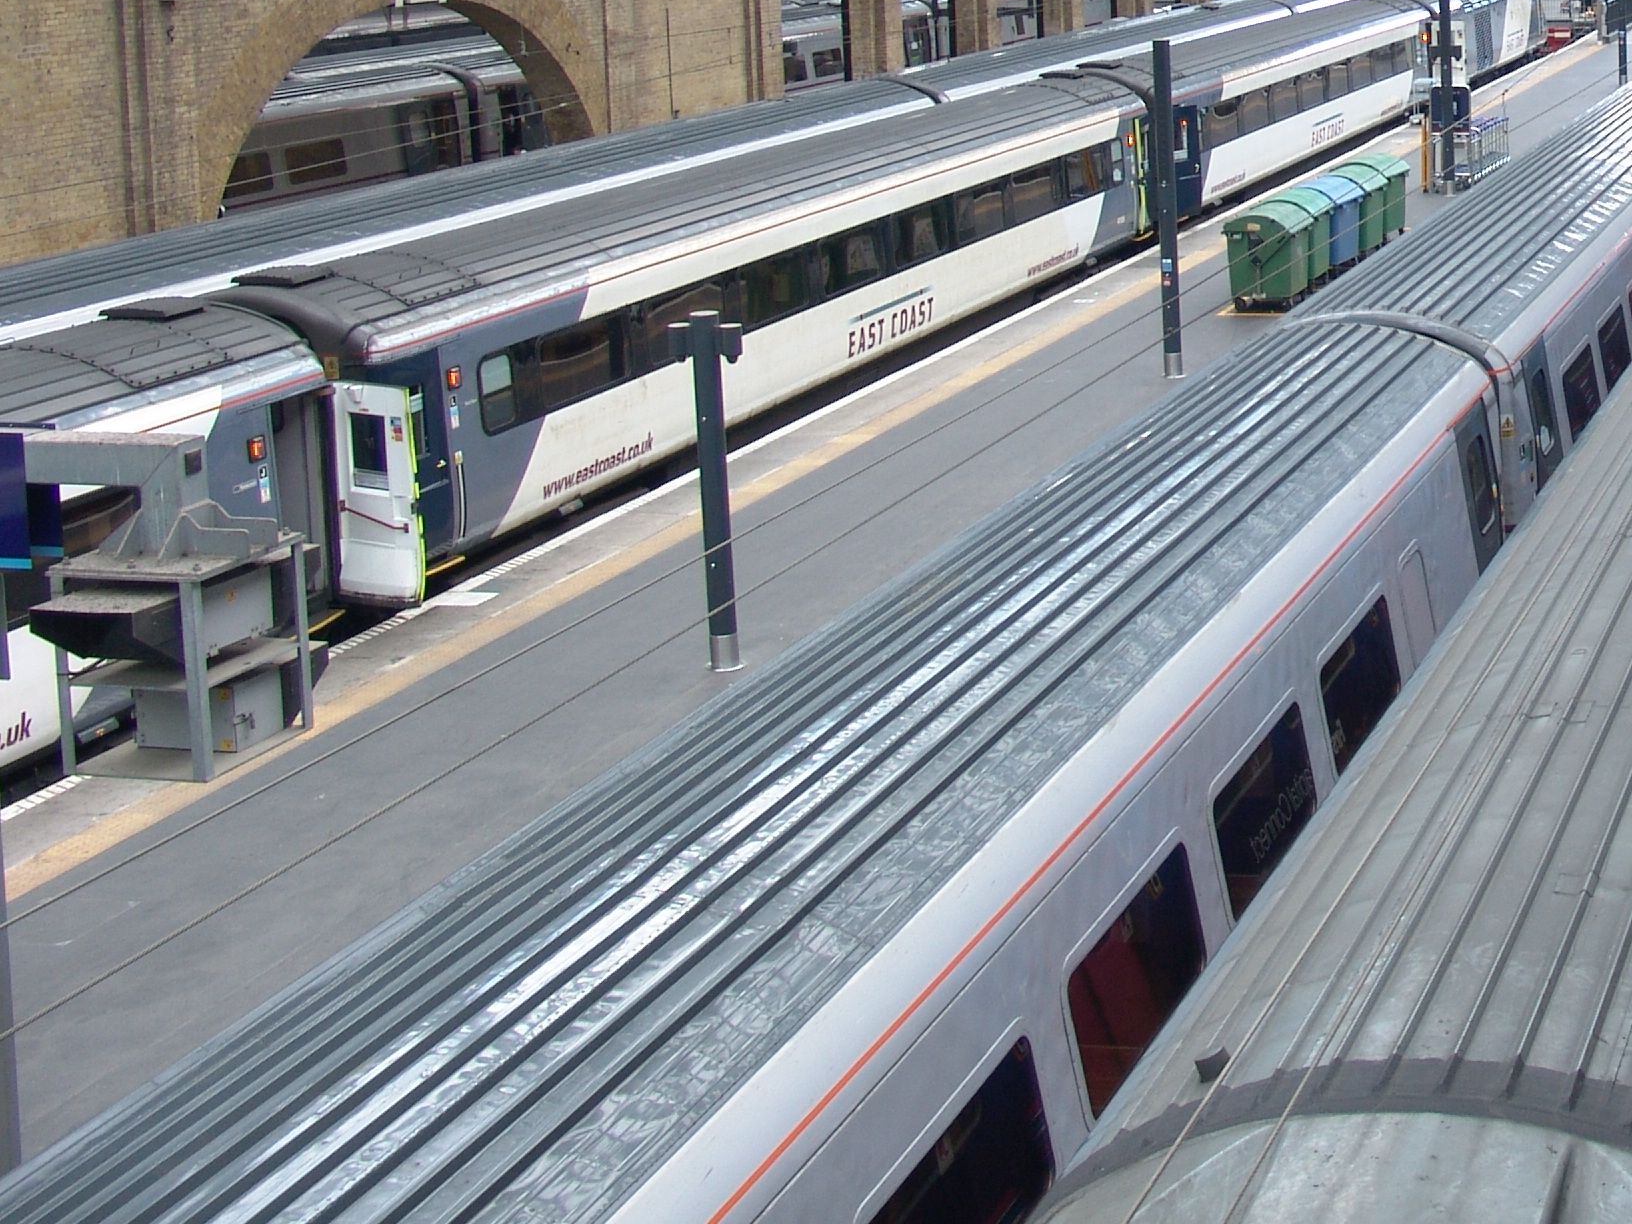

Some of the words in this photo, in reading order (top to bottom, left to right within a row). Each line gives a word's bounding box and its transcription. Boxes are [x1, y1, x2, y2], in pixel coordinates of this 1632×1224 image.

[1311, 126, 1326, 147] EAST
[1327, 119, 1344, 140] COAST
[848, 317, 885, 358] EAST
[890, 296, 934, 339] COAST
[542, 431, 654, 500] www.eastcoast.co.uk
[0, 711, 32, 751] .uk
